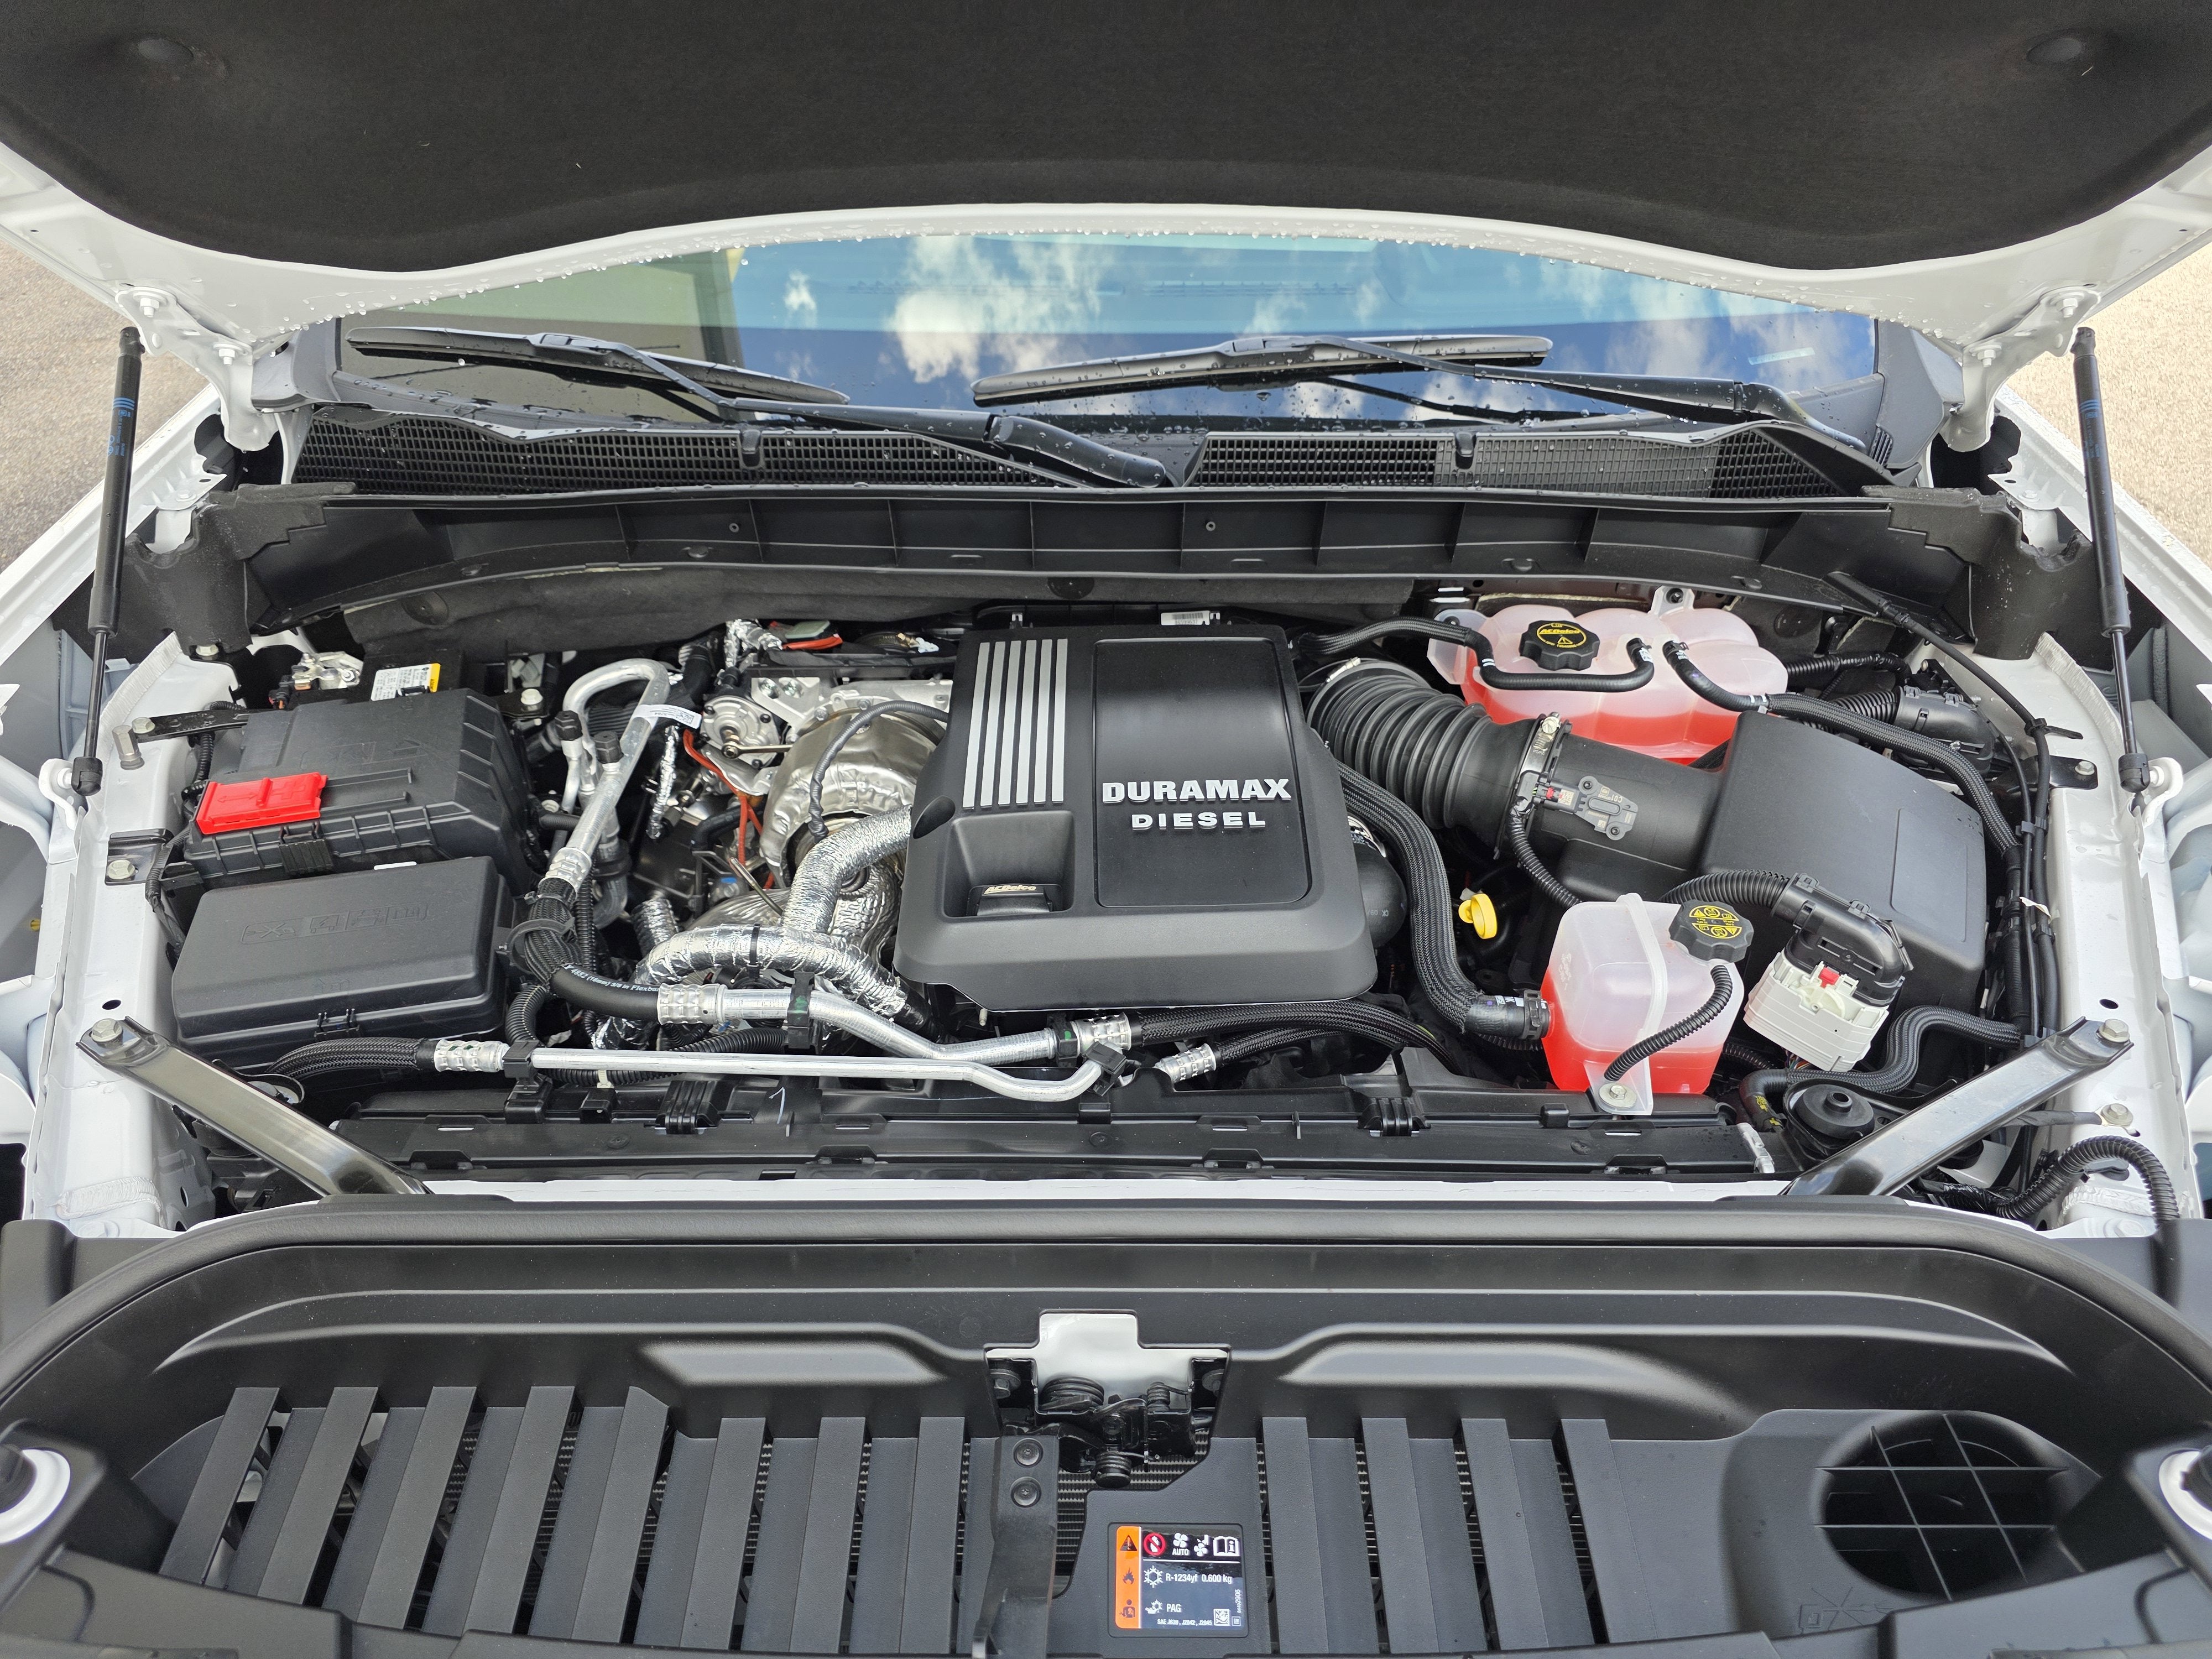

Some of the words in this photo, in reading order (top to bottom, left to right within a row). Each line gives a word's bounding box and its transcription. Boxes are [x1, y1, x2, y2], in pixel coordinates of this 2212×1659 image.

[1102, 779, 1292, 803] DURAMAX
[1131, 811, 1266, 830] DIESEL
[984, 884, 1037, 894] ACDelco
[1166, 1573, 1197, 1583] R-1234yf
[1223, 1575, 1232, 1584] kg
[1166, 1604, 1181, 1613] PAG
